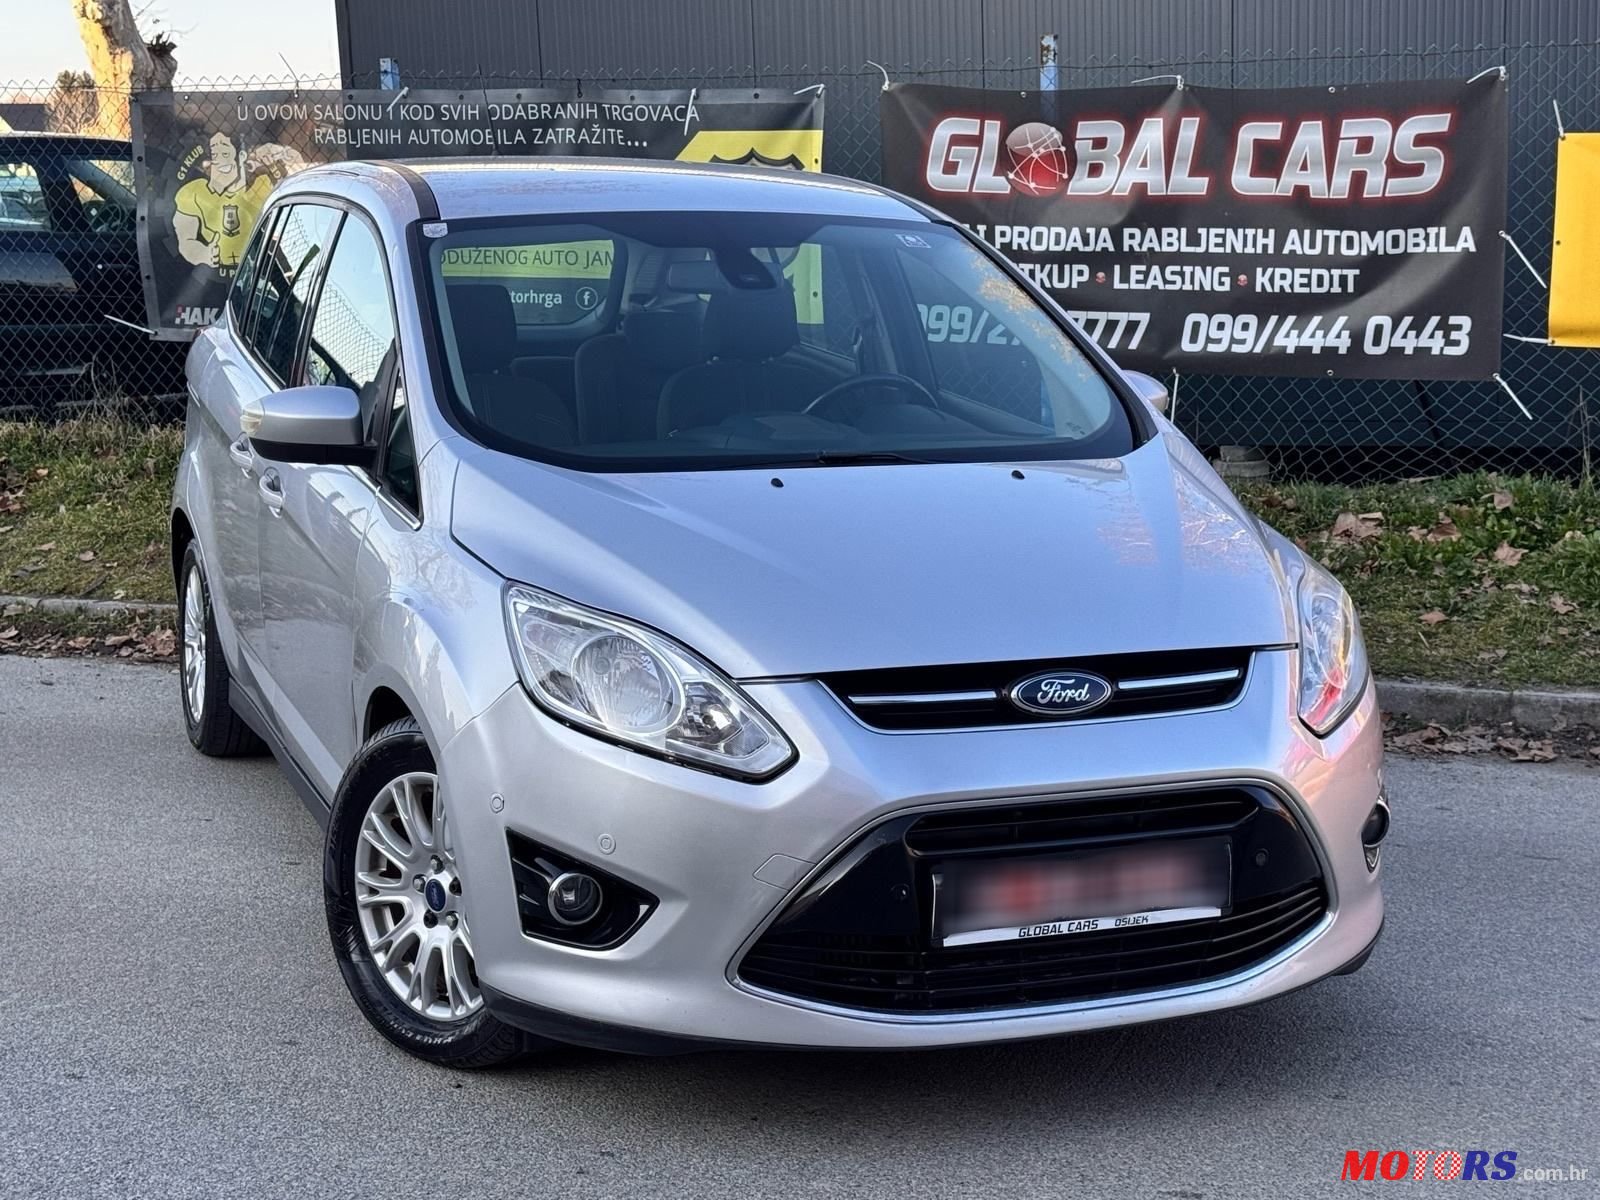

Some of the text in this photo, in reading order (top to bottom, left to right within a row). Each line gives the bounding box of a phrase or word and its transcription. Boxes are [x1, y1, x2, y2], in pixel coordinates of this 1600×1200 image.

[237, 105, 249, 121] U
[254, 105, 308, 121] OVOM
[313, 104, 382, 121] SALONU
[400, 104, 435, 121] KOD
[440, 104, 479, 120] SVIH
[488, 103, 598, 121] ODABRANIH
[602, 104, 700, 122] TRGOVACA
[315, 128, 401, 147] RABLJENIH
[177, 145, 204, 180] G1 KLUB
[926, 113, 1452, 198] GLOBAL CARS
[994, 224, 1115, 252] PRODAJA
[1123, 226, 1276, 255] RABLJENIH
[1282, 226, 1477, 256] AUTOMOBILA
[532, 250, 579, 266] AUTO
[1015, 262, 1360, 293] TKUP LEASING KREDIT
[175, 305, 219, 326] HAK
[1181, 313, 1352, 354] 099/444
[1363, 315, 1472, 356] 0443
[1036, 678, 1090, 704] Ford
[1018, 915, 1149, 938] GLOBAL CARS OSIJEK
